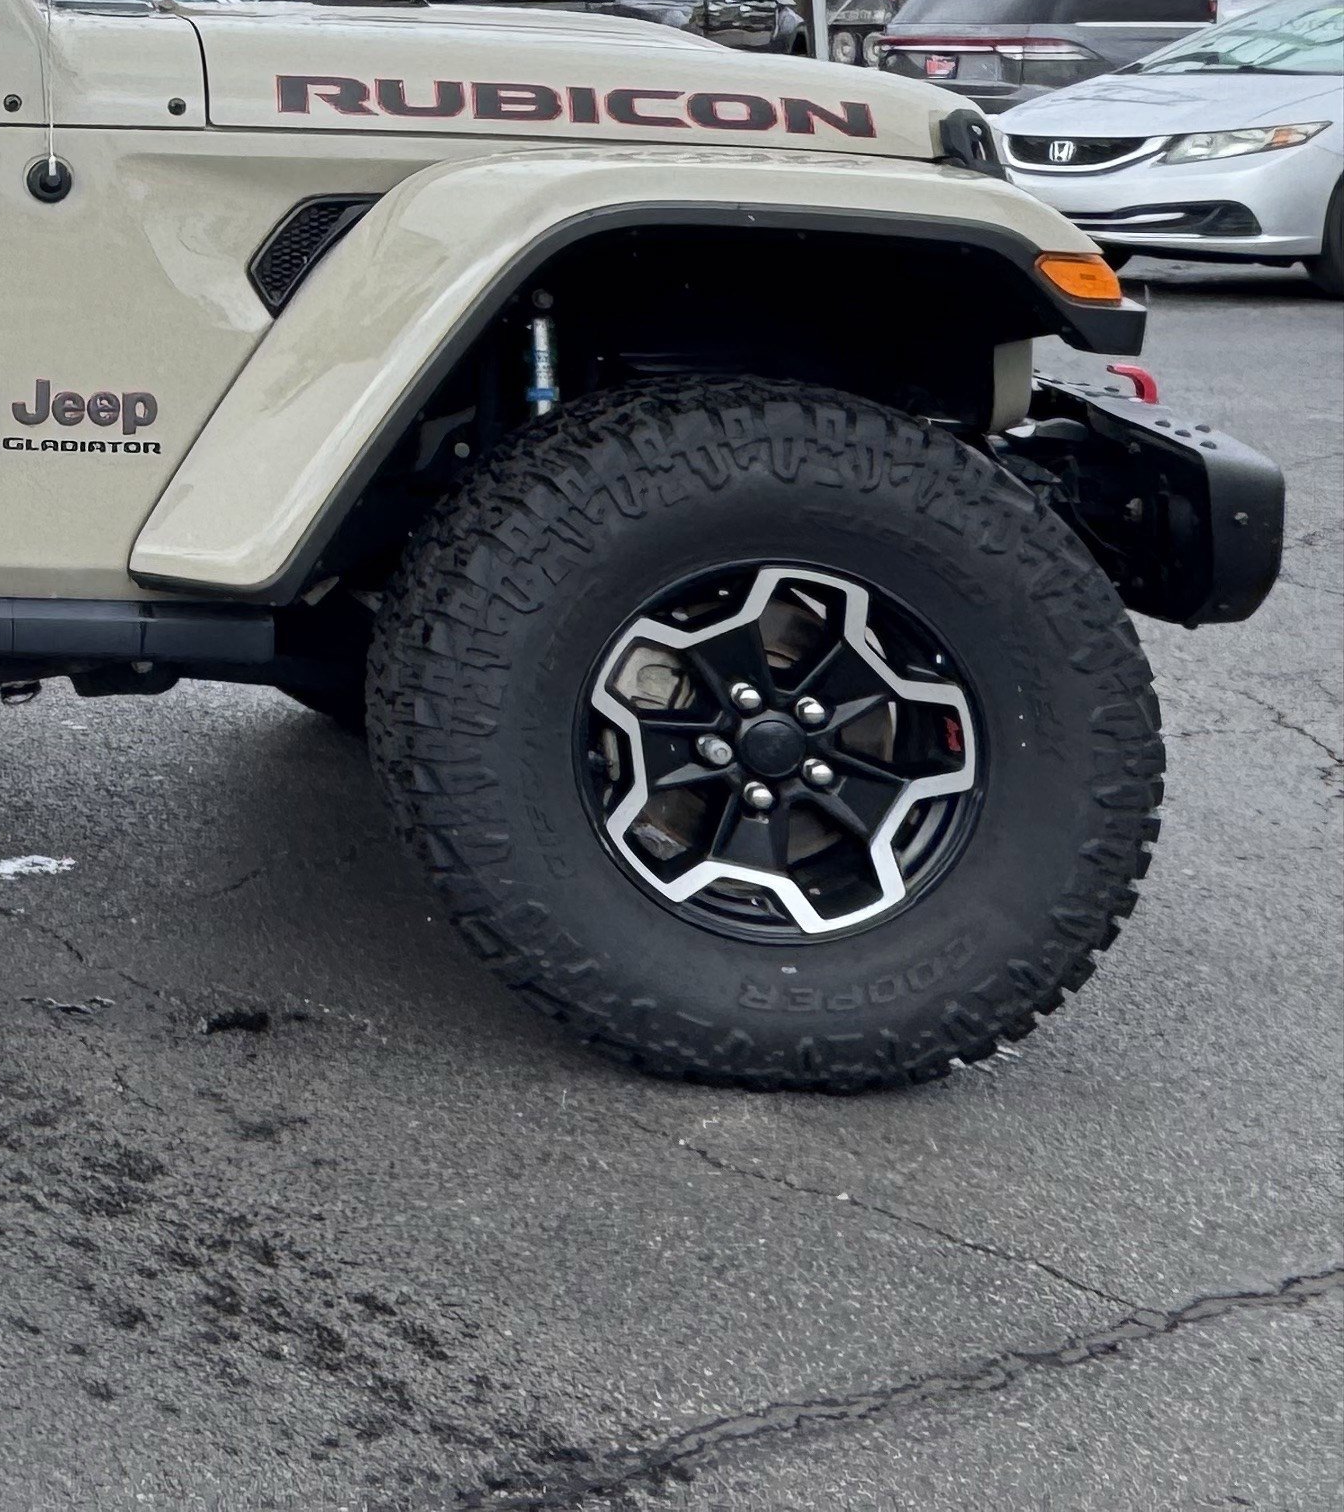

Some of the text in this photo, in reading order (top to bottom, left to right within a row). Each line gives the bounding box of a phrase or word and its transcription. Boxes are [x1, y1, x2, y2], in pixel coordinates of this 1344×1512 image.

[274, 73, 877, 139] RUBICON
[11, 378, 159, 436] Jeep
[2, 437, 162, 455] GLADIATOR
[737, 935, 980, 1014] COOPER
